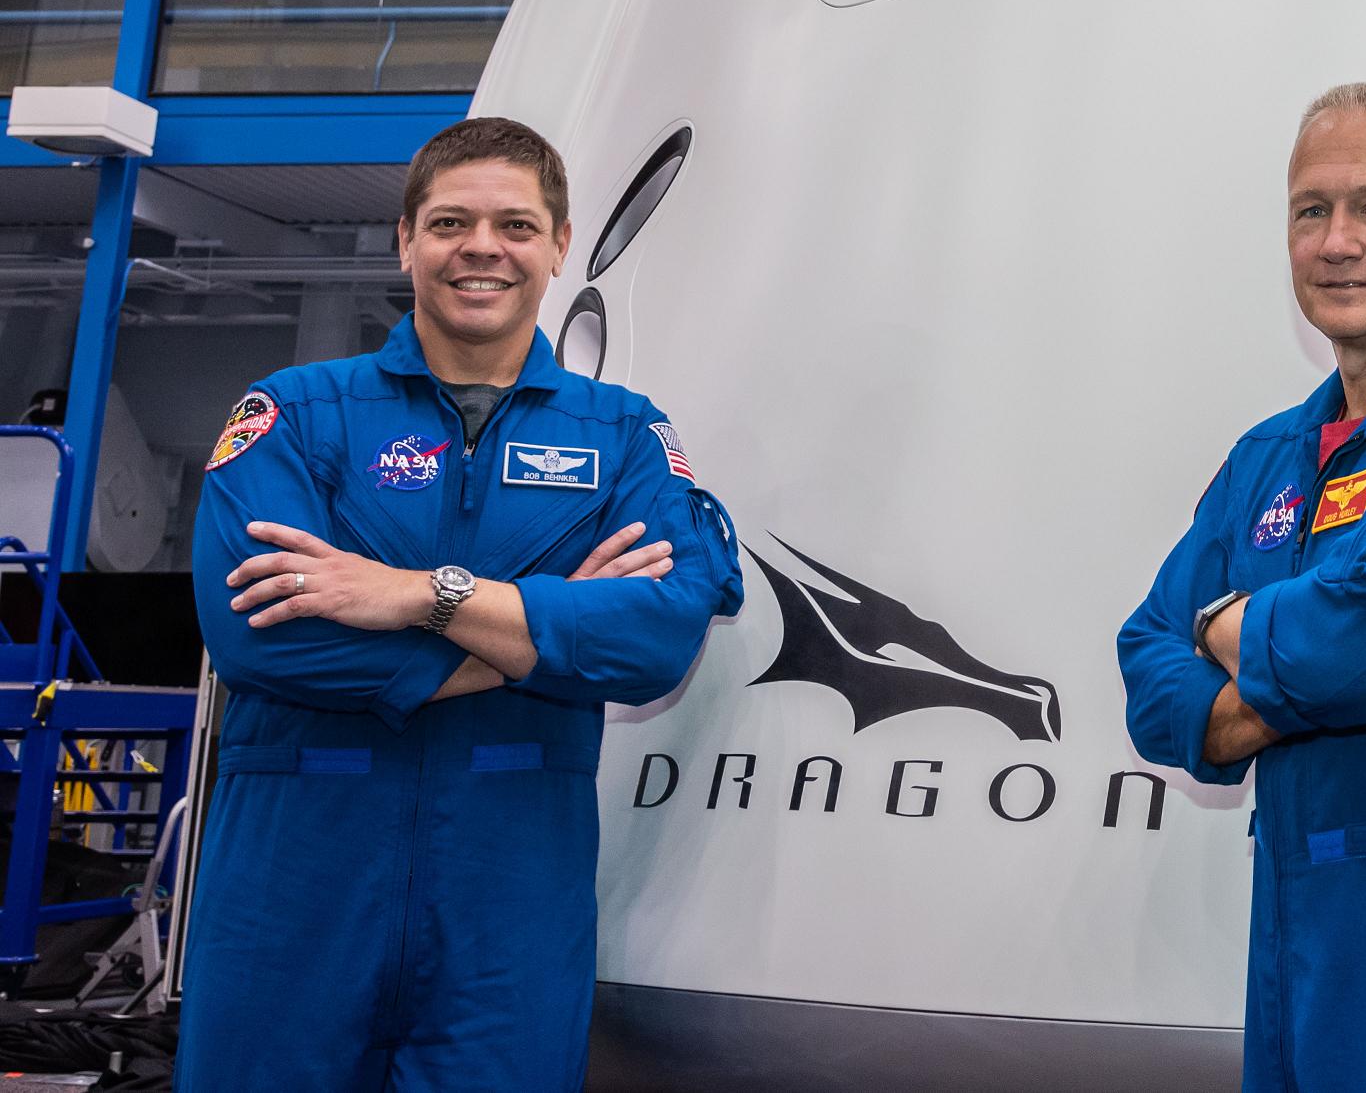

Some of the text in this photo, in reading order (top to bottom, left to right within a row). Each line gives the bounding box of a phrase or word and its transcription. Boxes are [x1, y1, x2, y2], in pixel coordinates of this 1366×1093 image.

[379, 452, 440, 470] NASA
[523, 471, 579, 483] BOB BEHNKEN
[1259, 506, 1295, 526] NASA
[632, 753, 1168, 831] DRAGON
